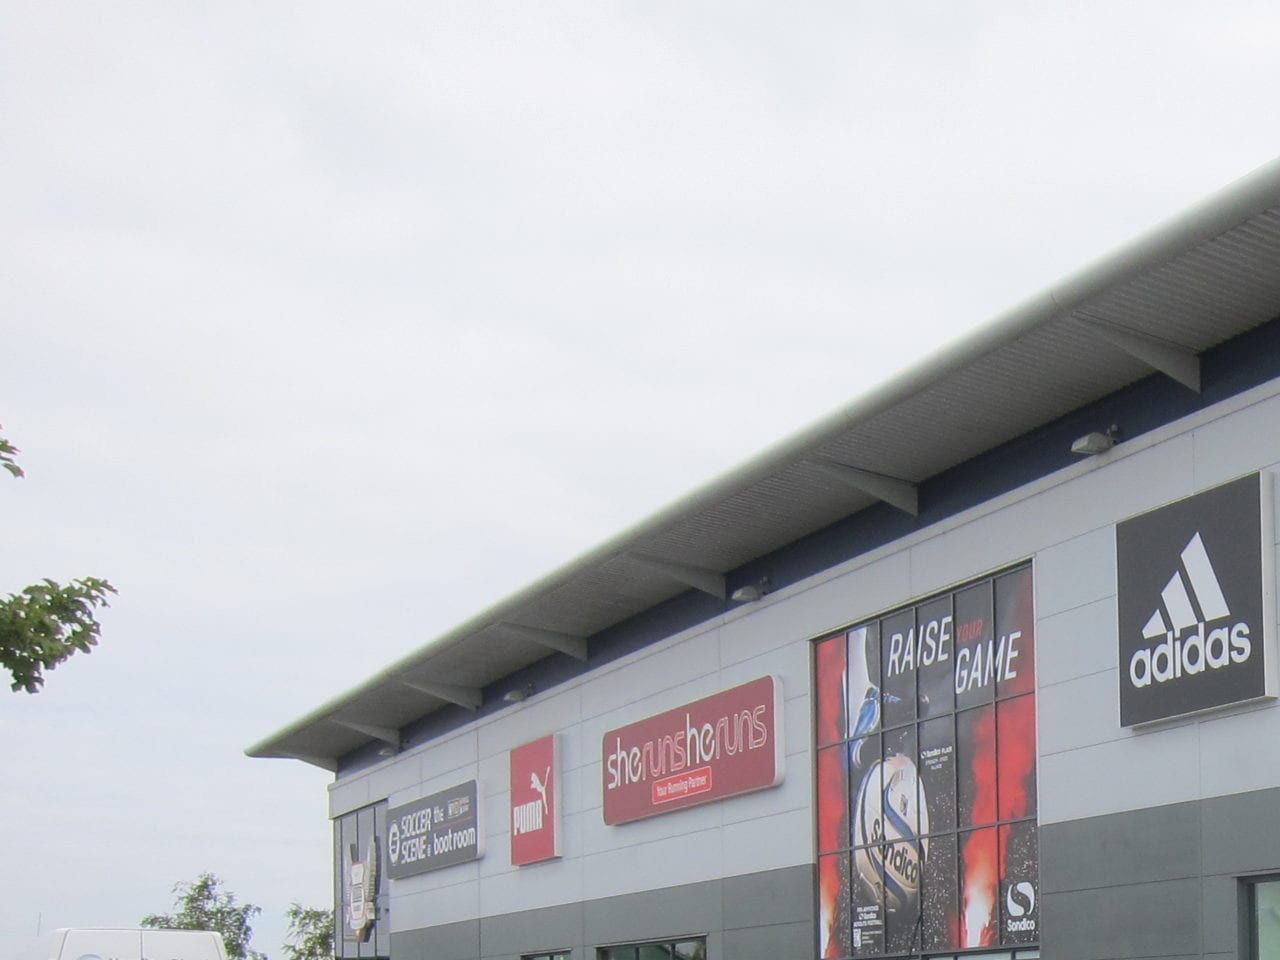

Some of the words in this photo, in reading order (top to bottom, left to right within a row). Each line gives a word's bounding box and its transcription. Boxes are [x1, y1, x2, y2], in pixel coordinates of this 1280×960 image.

[957, 619, 983, 643] YOUR
[888, 616, 952, 677] RAISE
[1130, 622, 1251, 688] adidas
[956, 631, 1021, 694] GAME
[656, 783, 667, 797] Your
[667, 778, 688, 793] Running
[688, 774, 707, 789] Partner
[401, 807, 431, 839] SOCCER
[434, 805, 444, 823] the
[513, 799, 543, 836] PUMA
[401, 835, 427, 864] SCENE
[434, 829, 452, 855] boot
[452, 827, 476, 850] room
[1007, 917, 1036, 932] Sondico
